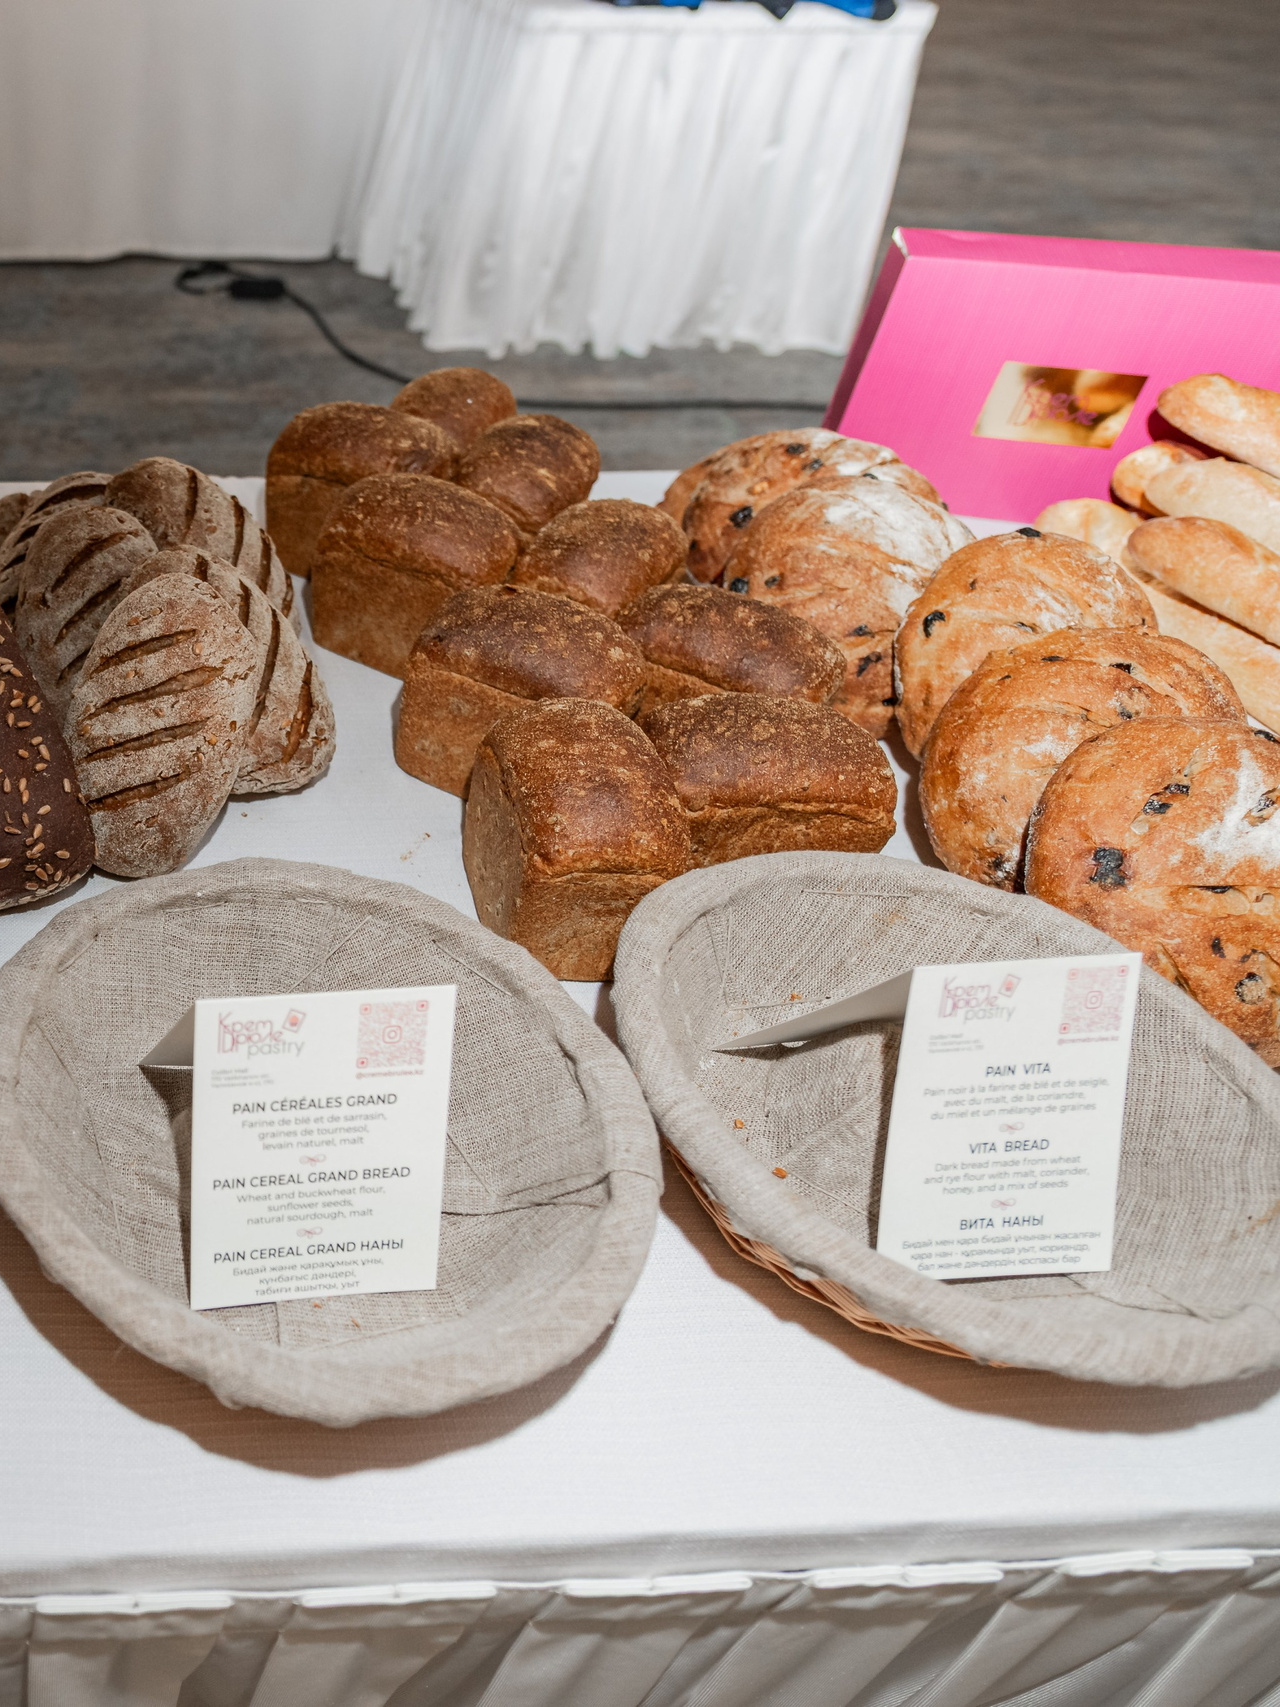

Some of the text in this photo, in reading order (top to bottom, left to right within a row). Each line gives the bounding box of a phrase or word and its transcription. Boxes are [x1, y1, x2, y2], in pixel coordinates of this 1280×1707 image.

[963, 1004, 1016, 1024] pastry
[247, 1039, 305, 1059] pastry
[985, 1064, 1051, 1077] PAIN VITA
[232, 1094, 397, 1114] PAIN CÉRÉALES GRAND
[969, 1140, 1049, 1154] VITA BREAD
[213, 1167, 410, 1190] PAIN CEREAL GRAND BREAD
[959, 1216, 1043, 1230] ВИТА НАНЫ
[214, 1240, 403, 1264] PAIN CEREAL GRAND НАНЫ
